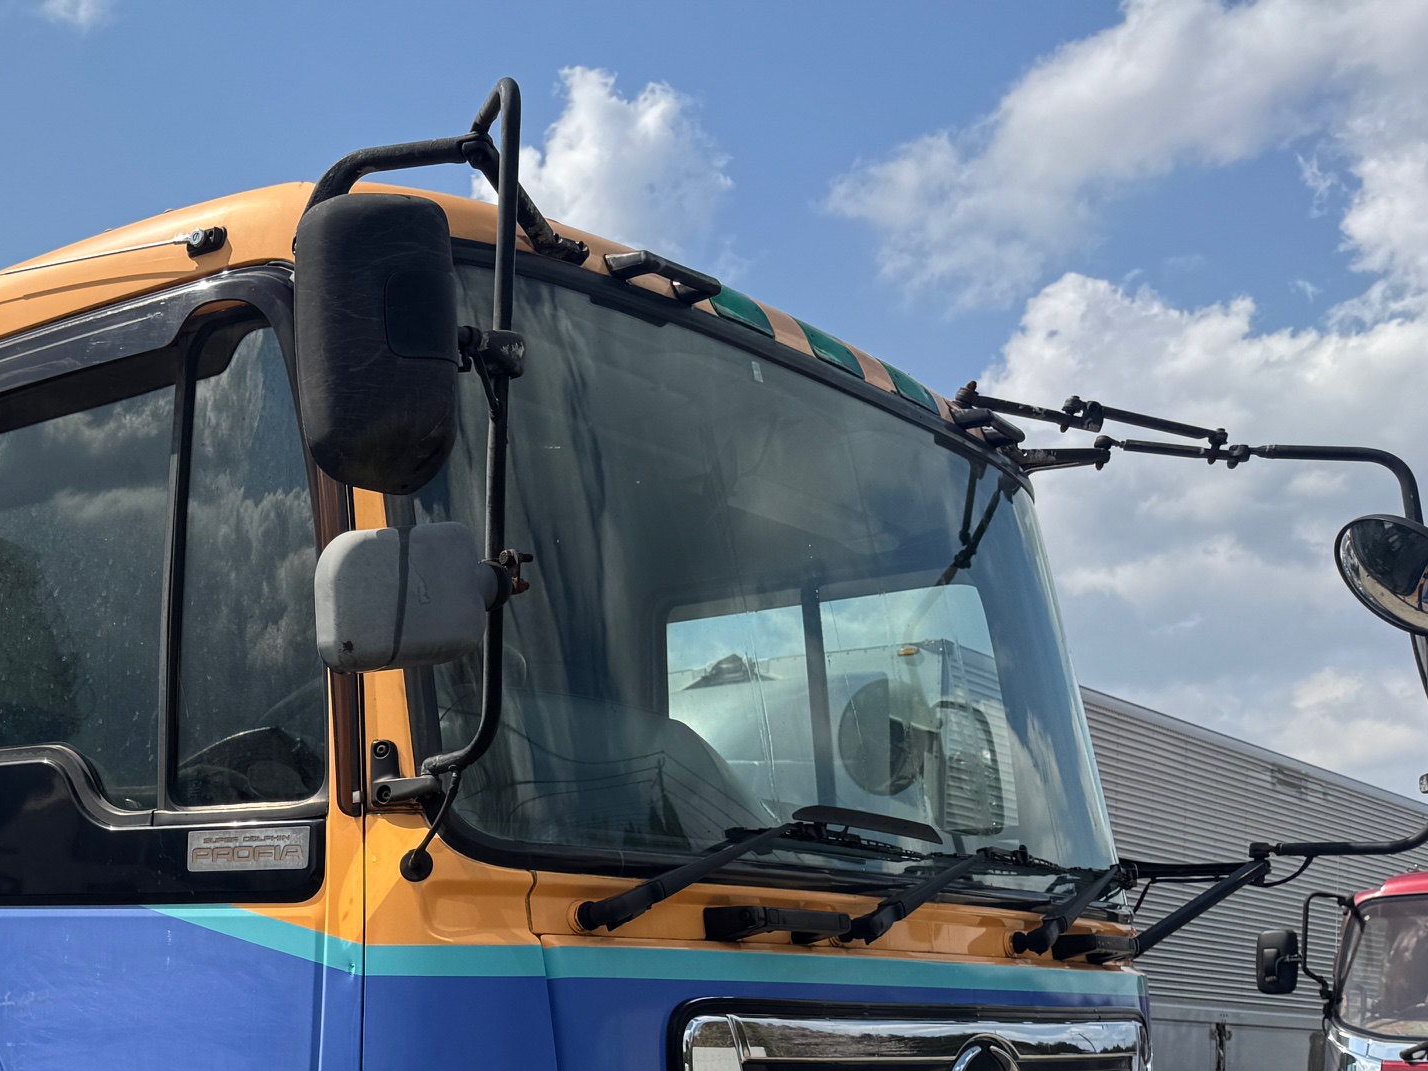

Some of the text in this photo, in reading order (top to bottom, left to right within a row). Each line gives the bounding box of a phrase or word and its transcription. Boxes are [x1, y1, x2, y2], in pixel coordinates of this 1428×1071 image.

[203, 834, 291, 844] SUPER DOLPHIN
[192, 844, 303, 864] PROFIA
